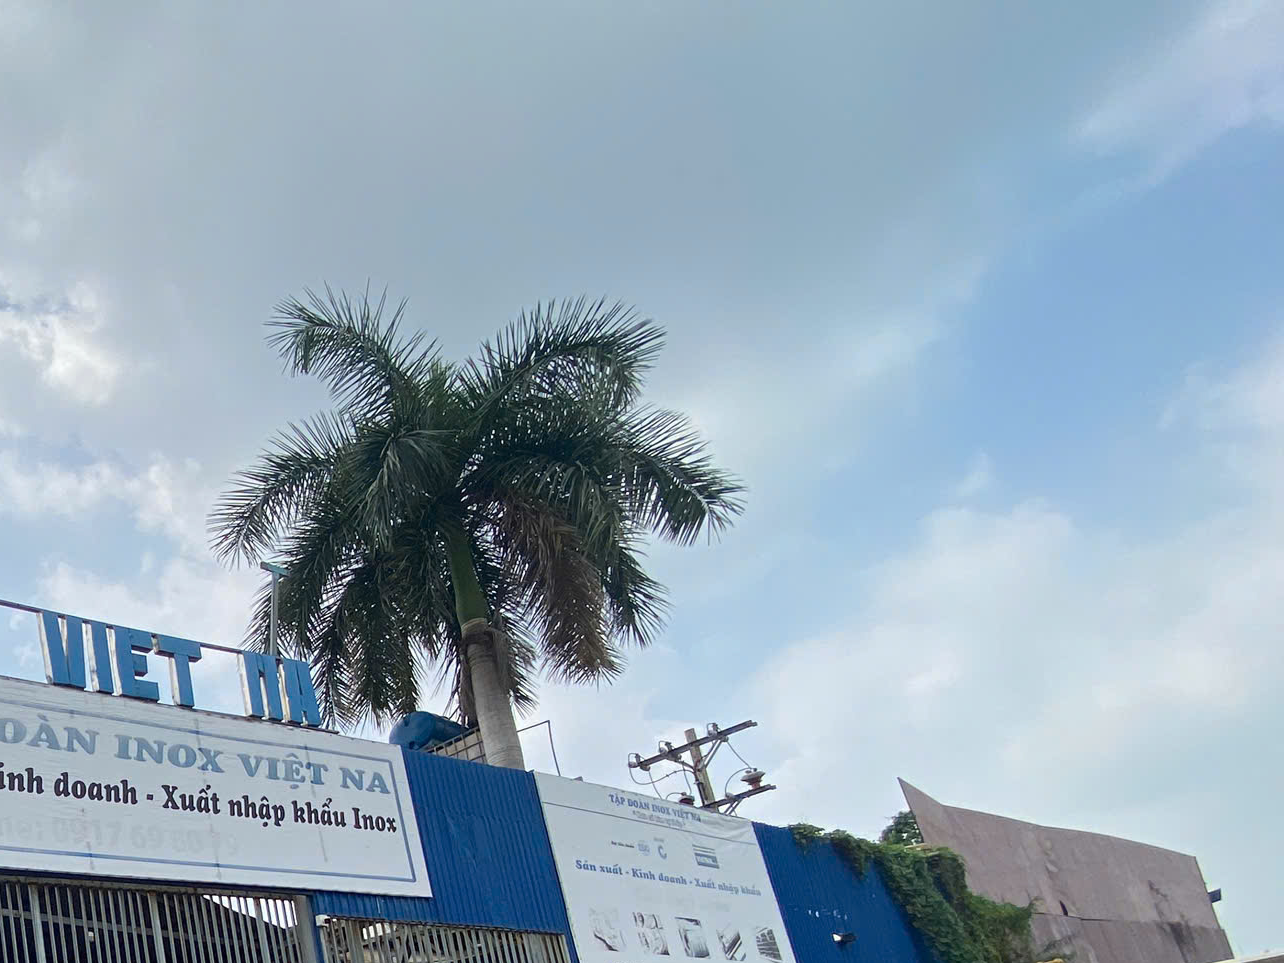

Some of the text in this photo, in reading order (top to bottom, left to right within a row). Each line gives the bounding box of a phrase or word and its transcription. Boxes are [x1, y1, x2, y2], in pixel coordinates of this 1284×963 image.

[36, 608, 203, 709] VIET
[236, 649, 323, 727] NA
[114, 733, 225, 773] INOX
[237, 753, 328, 789] VIỆT
[339, 767, 391, 794] NA
[54, 772, 138, 805] doanh
[161, 784, 220, 815] Xuất
[228, 795, 285, 828] nhập
[292, 797, 347, 828] khẩu
[352, 807, 397, 833] Inox
[599, 863, 623, 876] xuất
[631, 867, 656, 881] Kinh
